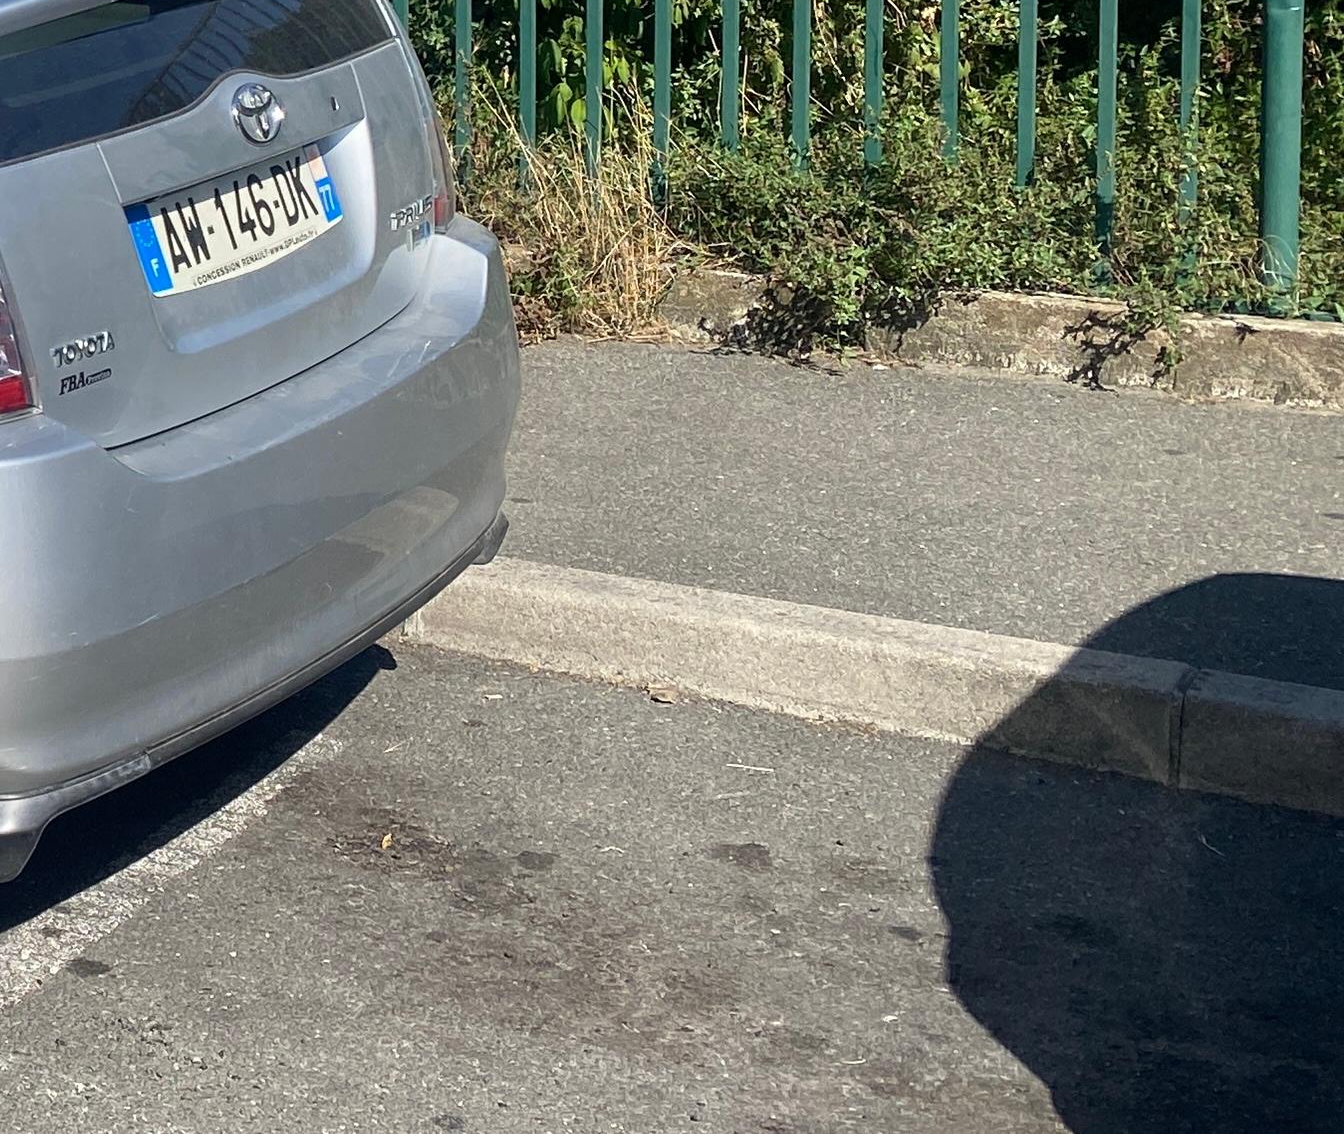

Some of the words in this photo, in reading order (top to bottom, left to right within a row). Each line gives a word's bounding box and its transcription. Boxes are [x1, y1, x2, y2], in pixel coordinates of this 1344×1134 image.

[319, 183, 335, 213] 77
[161, 156, 318, 273] AW-146-DK
[151, 258, 160, 278] F
[197, 260, 241, 286] CONCESSION
[49, 331, 115, 368] TOYOTA
[59, 371, 86, 396] FBA
